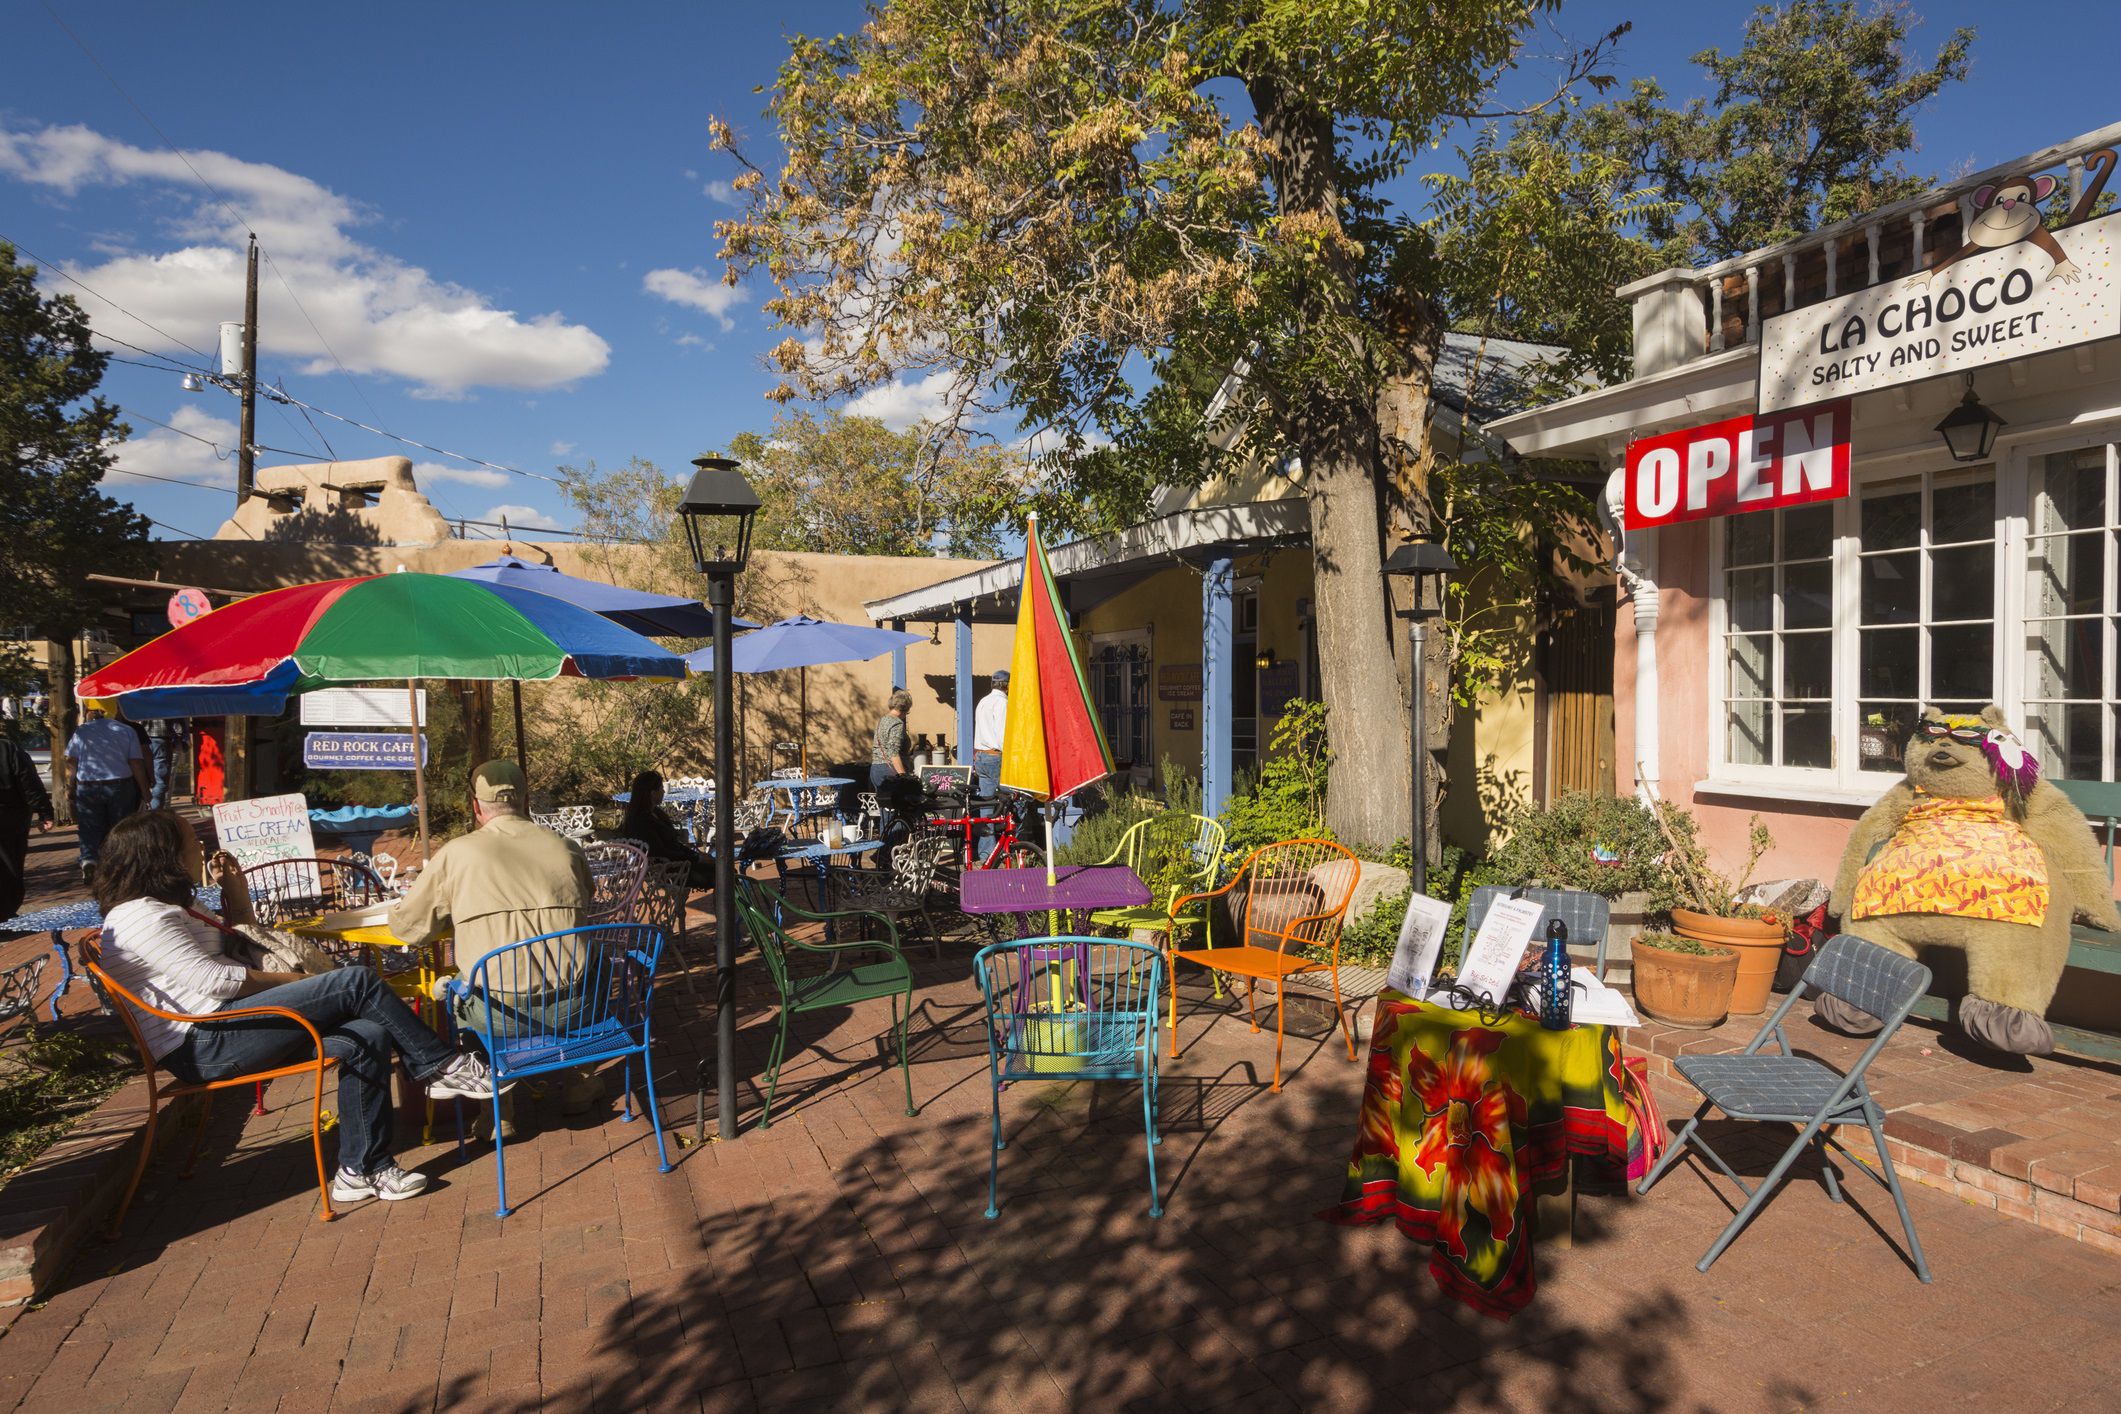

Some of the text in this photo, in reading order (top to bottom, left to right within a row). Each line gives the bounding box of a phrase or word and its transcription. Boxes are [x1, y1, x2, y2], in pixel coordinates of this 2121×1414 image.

[1819, 267, 2034, 355] LA CHOCO
[1811, 311, 2044, 386] SALTY AND SWEET
[1636, 411, 1835, 518] OPEN
[1173, 720, 1189, 728] BACK
[312, 740, 340, 752] RED
[343, 741, 378, 752] ROCK
[929, 774, 954, 785] JUICE
[216, 803, 245, 823] Fruit
[223, 823, 258, 843] ICE
